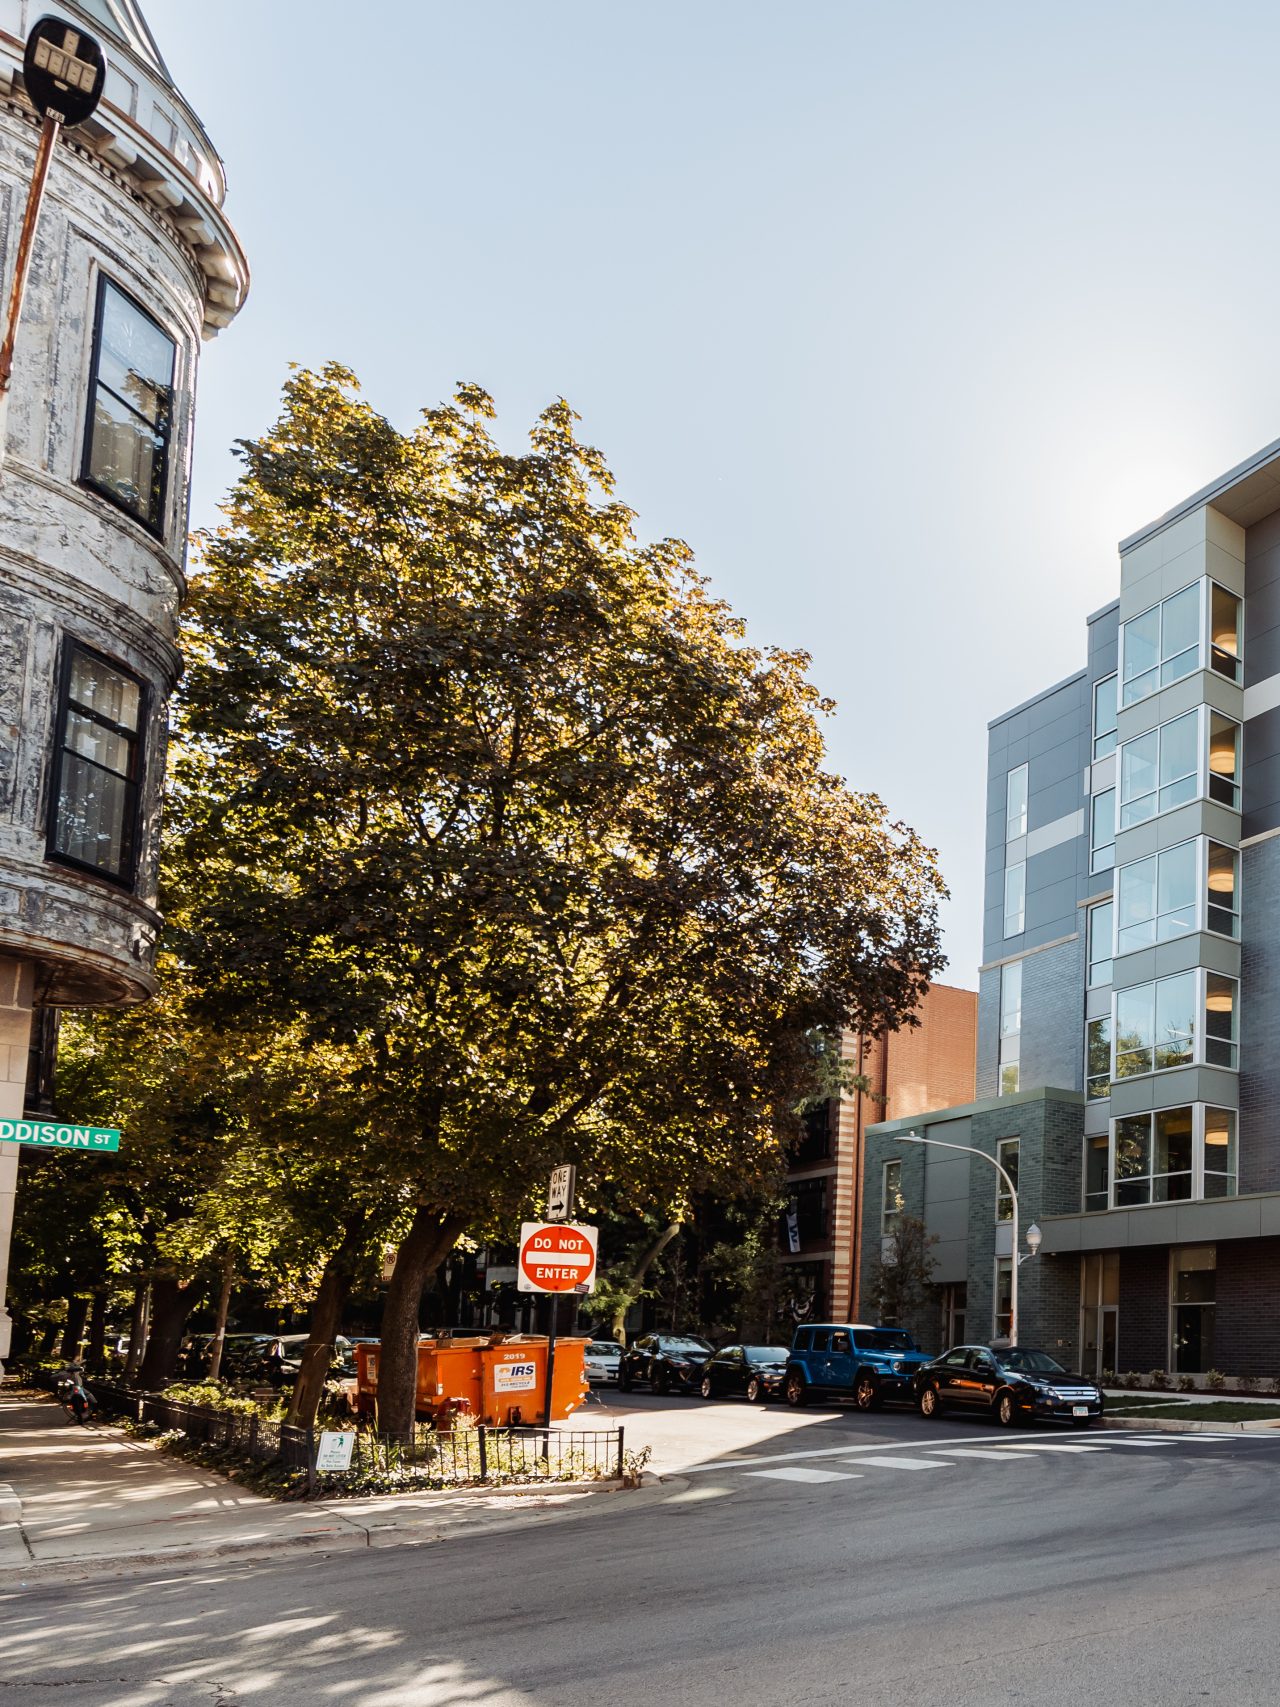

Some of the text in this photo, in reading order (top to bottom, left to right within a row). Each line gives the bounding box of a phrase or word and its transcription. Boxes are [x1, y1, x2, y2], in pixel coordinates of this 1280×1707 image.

[94, 1134, 111, 1144] ST
[552, 1170, 567, 1185] ONE
[551, 1185, 566, 1199] WAY
[534, 1238, 584, 1251] DO NOT
[536, 1267, 579, 1280] ENTER
[503, 1352, 526, 1361] 2019
[511, 1365, 534, 1376] IRS
